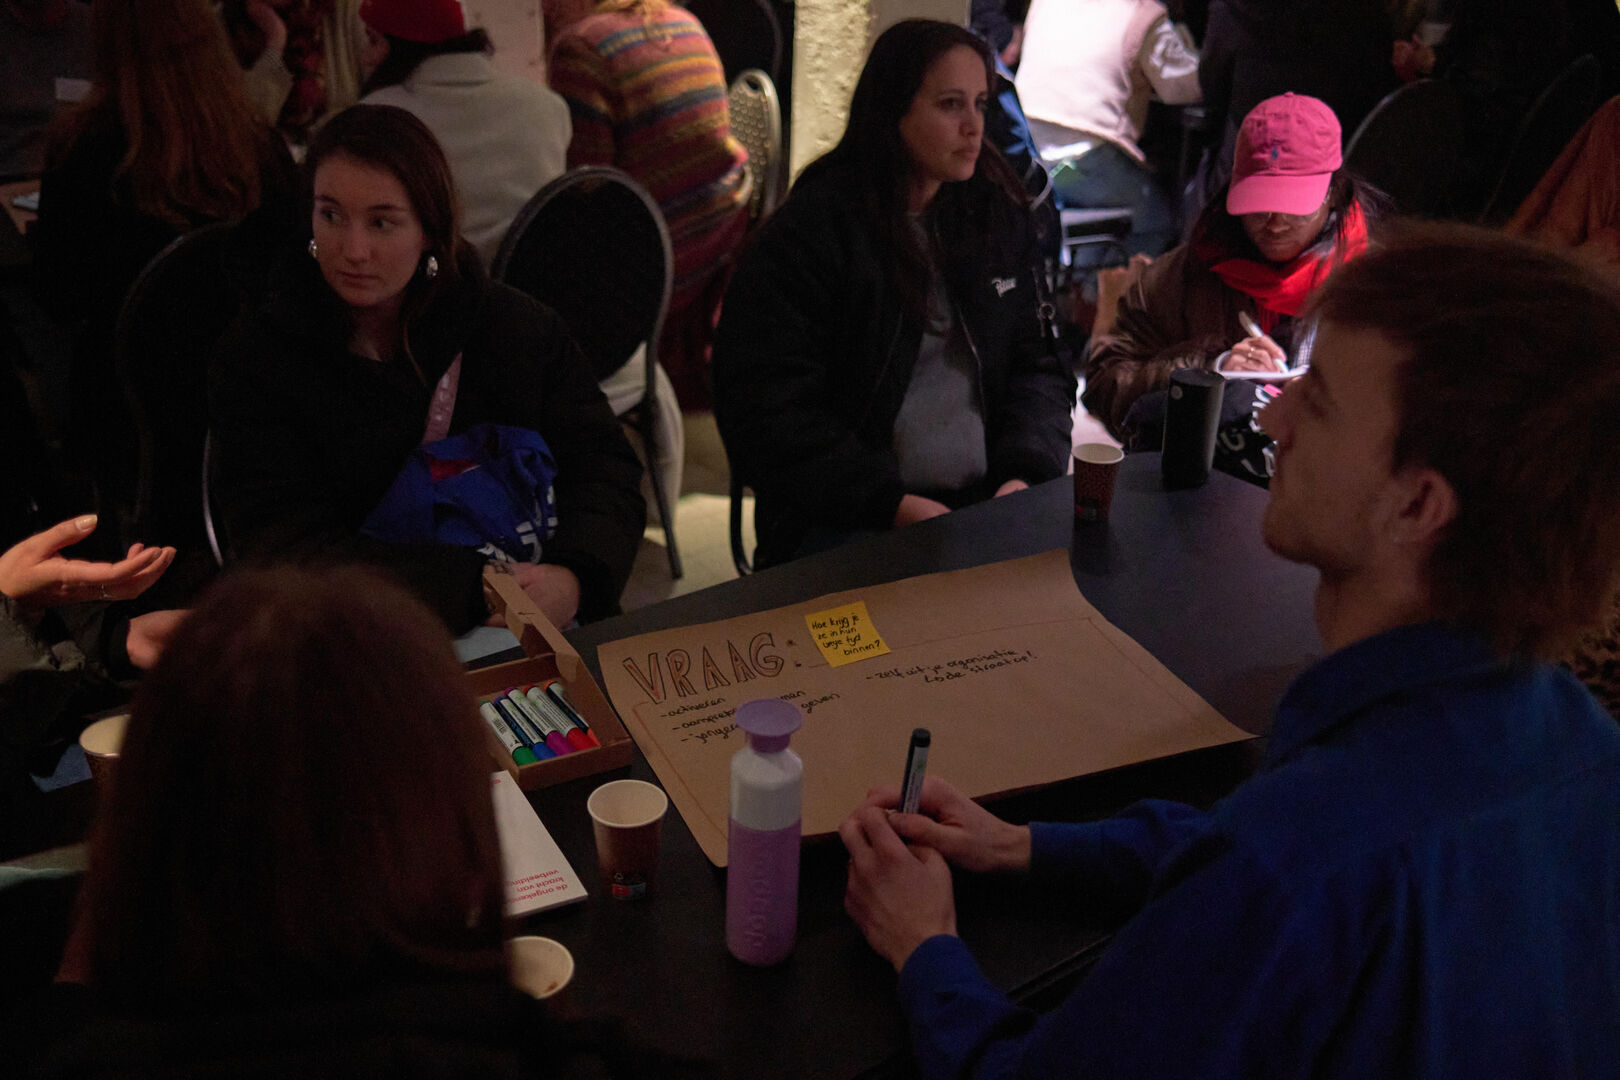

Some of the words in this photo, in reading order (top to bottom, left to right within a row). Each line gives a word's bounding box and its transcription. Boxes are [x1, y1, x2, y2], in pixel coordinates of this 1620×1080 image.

[811, 620, 828, 630] Hoe
[839, 626, 857, 636] hun
[843, 639, 880, 656] binnen?
[969, 658, 1012, 674] straat
[800, 692, 841, 714] geven
[516, 884, 535, 893] van
[536, 876, 565, 889] kracht
[555, 883, 569, 892] de
[508, 887, 555, 904] ongeken
